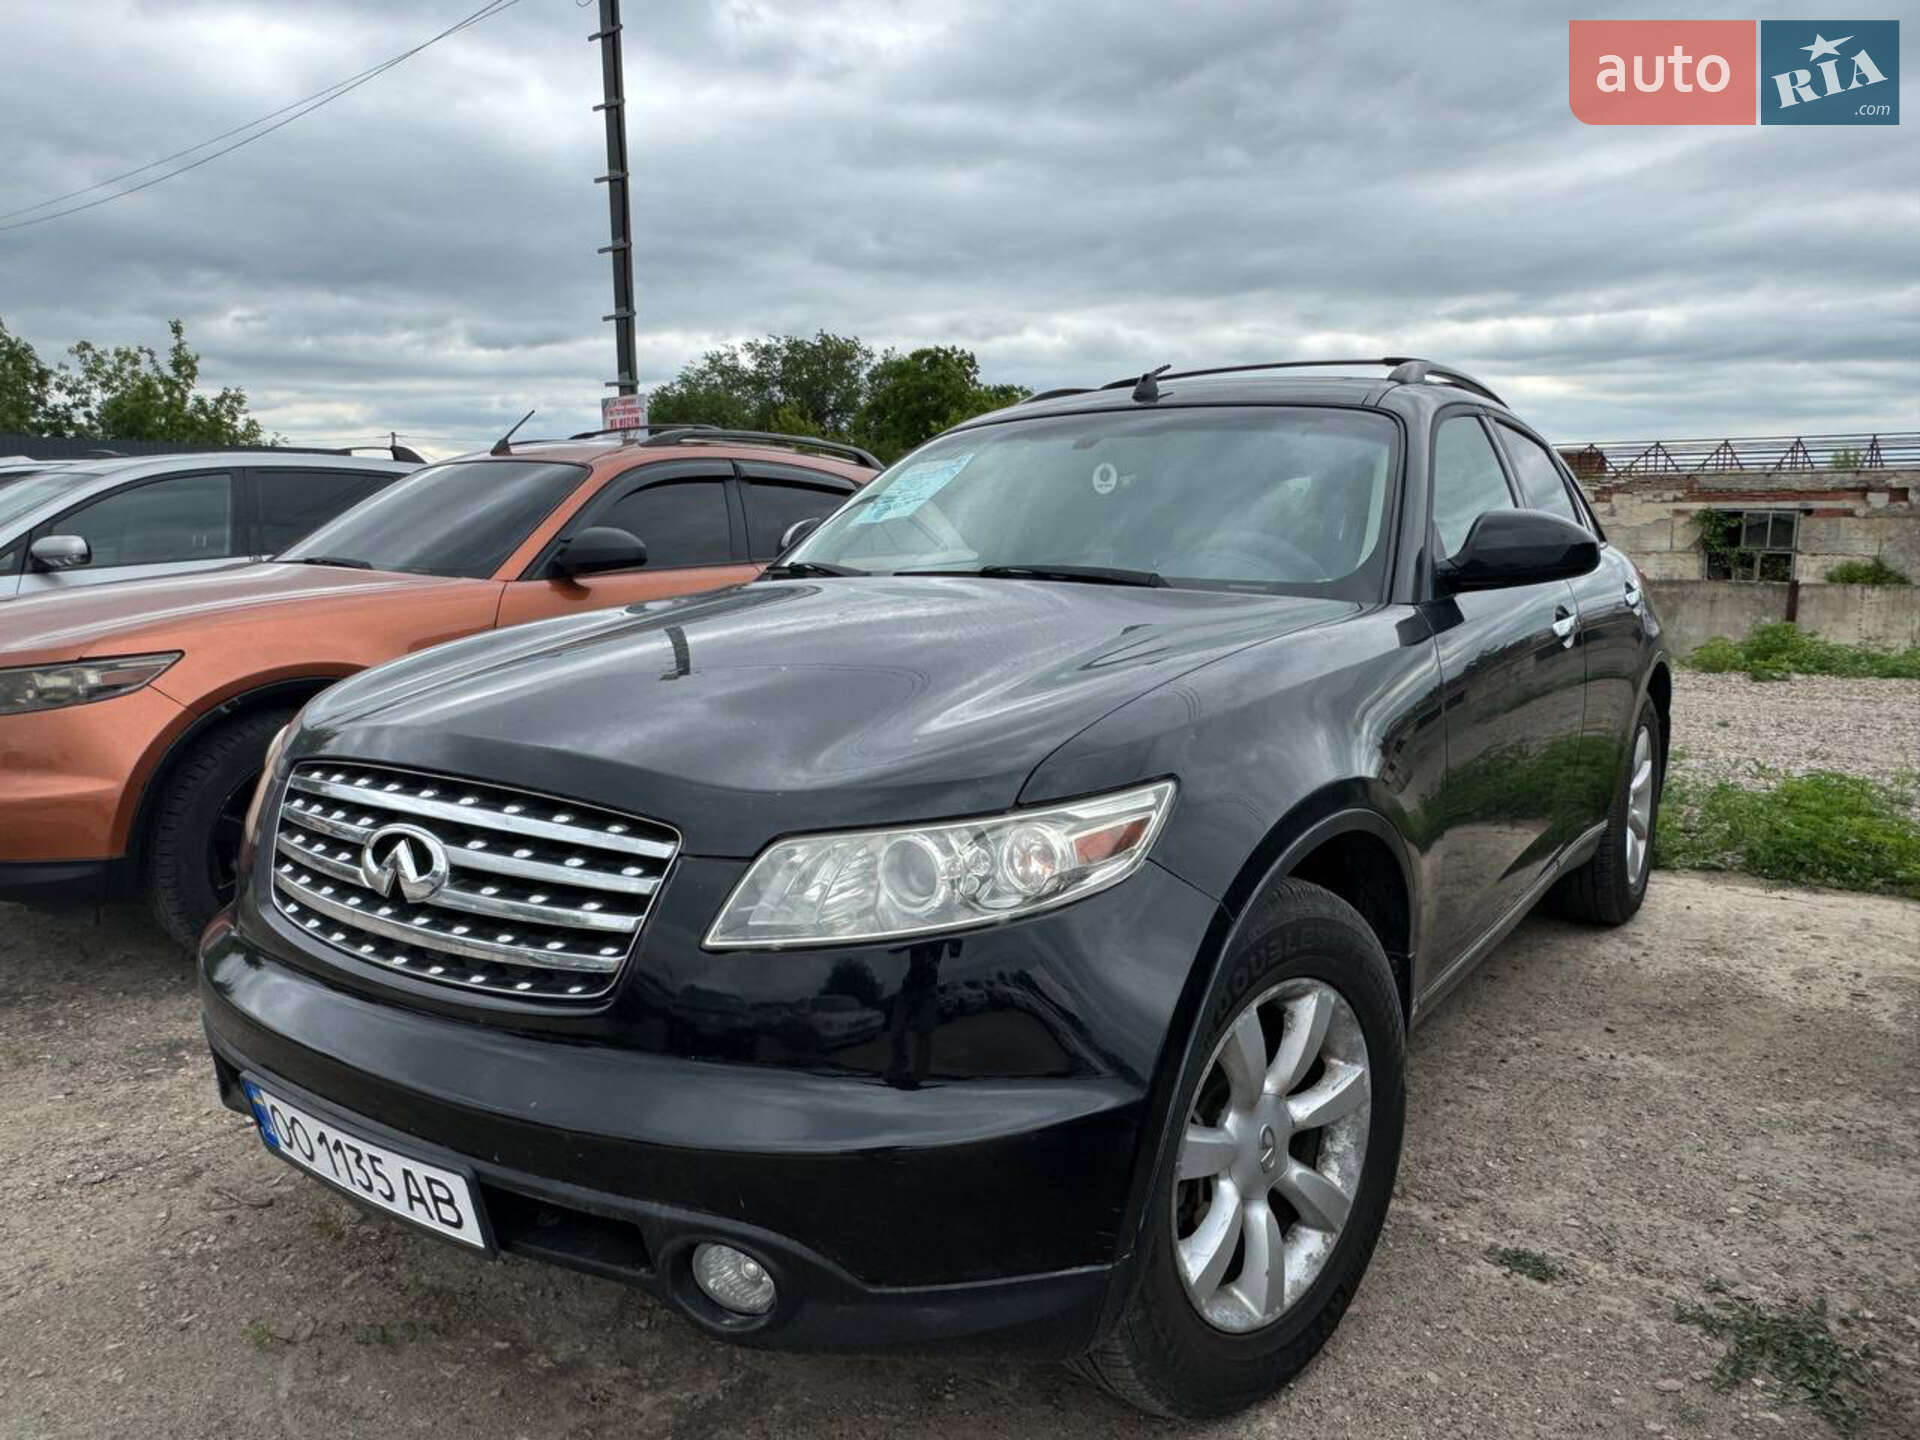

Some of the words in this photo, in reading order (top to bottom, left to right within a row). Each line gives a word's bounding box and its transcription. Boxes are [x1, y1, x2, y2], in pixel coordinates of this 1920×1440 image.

[270, 1104, 315, 1163] OO
[317, 1131, 395, 1203] 1135
[402, 1168, 464, 1230] AB
